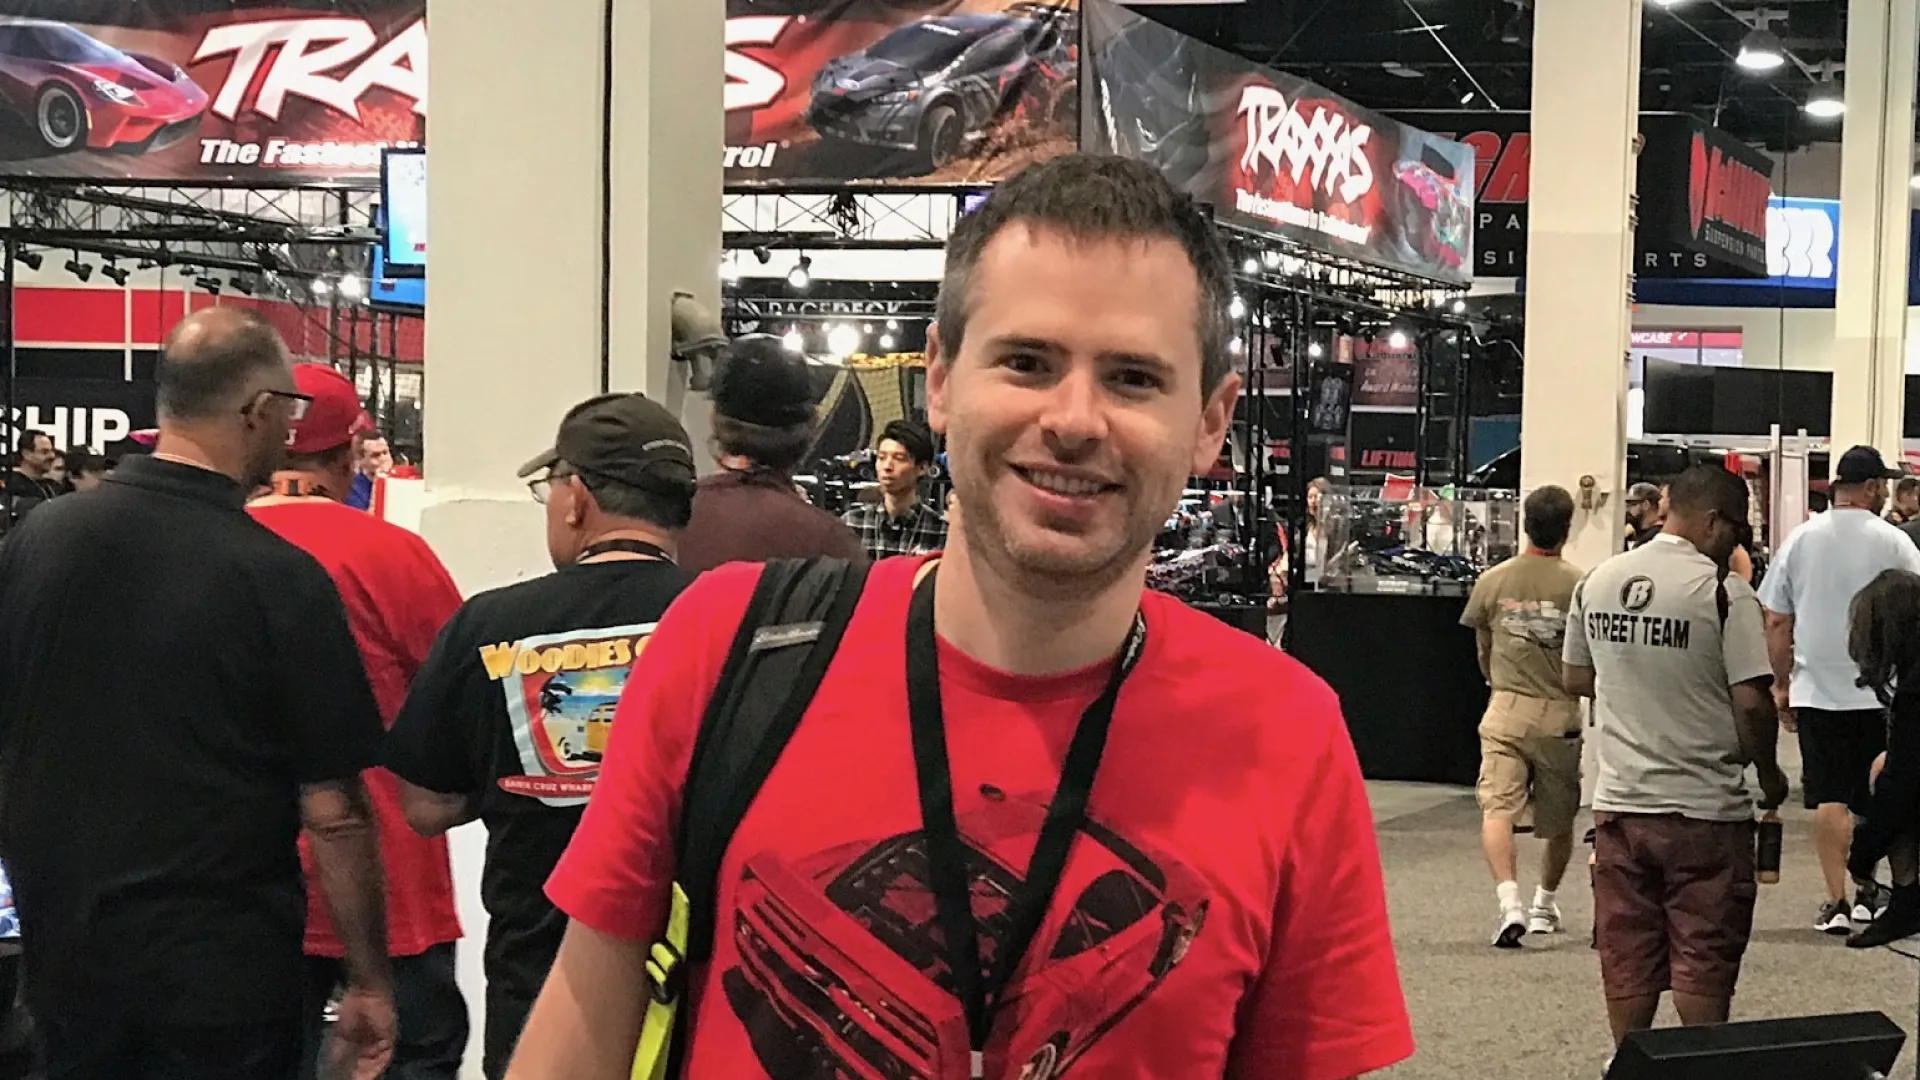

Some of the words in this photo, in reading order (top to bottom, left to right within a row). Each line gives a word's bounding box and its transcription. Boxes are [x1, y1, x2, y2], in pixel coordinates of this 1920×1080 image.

[200, 139, 259, 164] The
[723, 142, 777, 168] rol
[1236, 85, 1374, 204] TRAXXAS
[1588, 611, 1638, 644] STREET
[1642, 615, 1691, 649] TEAM
[479, 638, 632, 681] WOODIES
